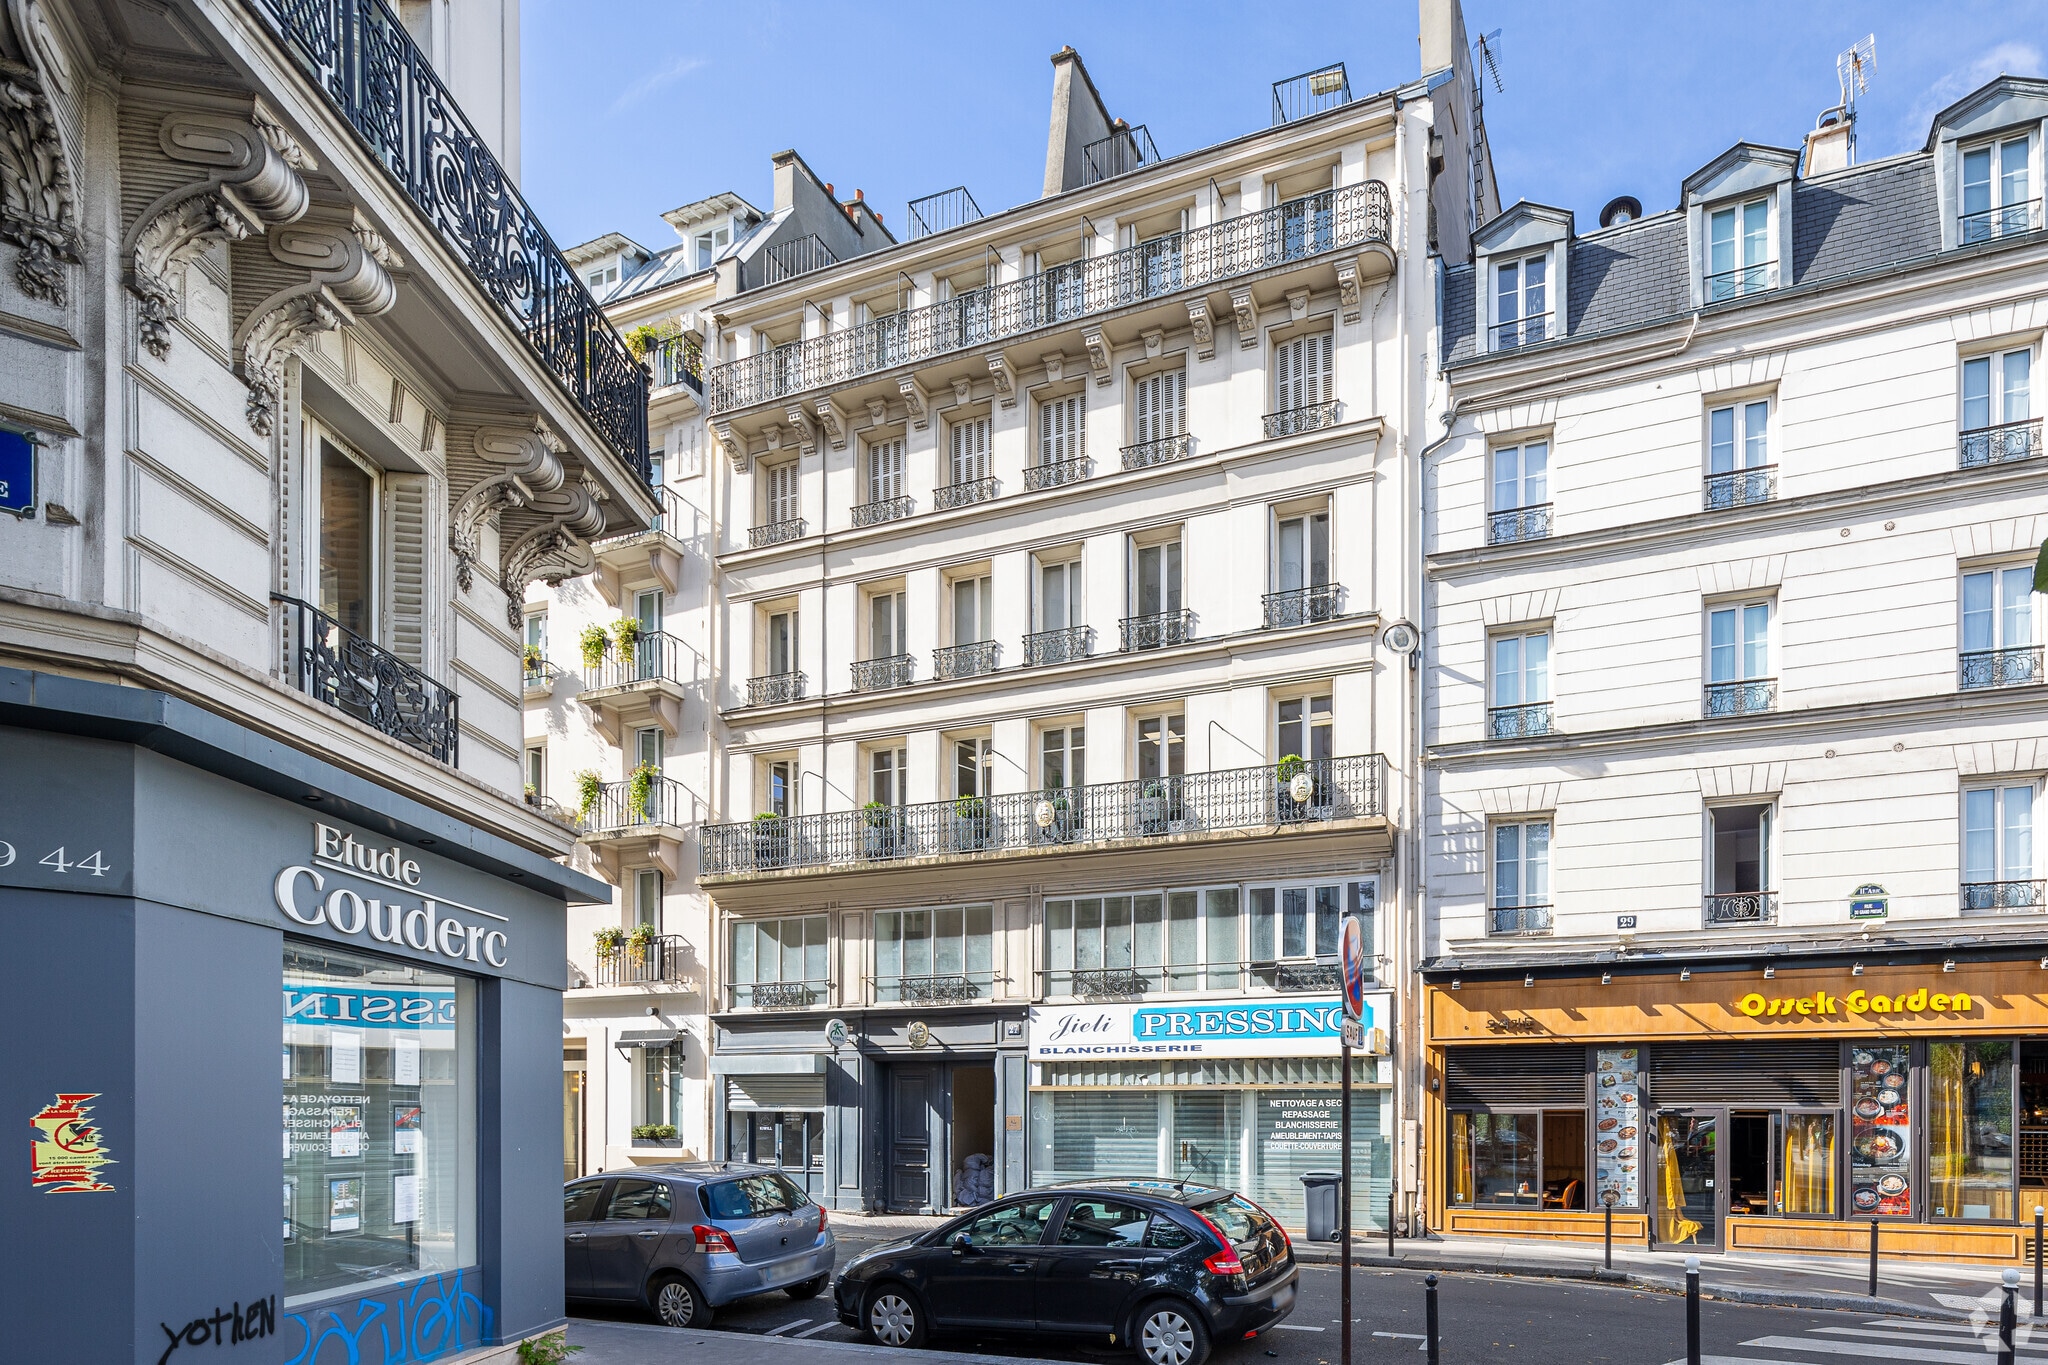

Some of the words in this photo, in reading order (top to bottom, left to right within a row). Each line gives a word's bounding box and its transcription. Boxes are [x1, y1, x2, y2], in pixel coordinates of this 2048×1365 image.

[313, 822, 421, 886] Etude
[39, 846, 111, 877] 44
[274, 866, 508, 968] Couderc
[1620, 916, 1634, 928] 29
[1741, 991, 1837, 1017] Ossek
[1847, 988, 1972, 1014] Garden
[1040, 1045, 1202, 1054] BLANCHISSERIE
[1325, 1099, 1342, 1107] SEC
[1282, 1110, 1330, 1118] REPASSAGE
[1275, 1121, 1338, 1129] BLANCHISSERIE
[1270, 1132, 1342, 1140] AMEUBLEMENT-TAPIS
